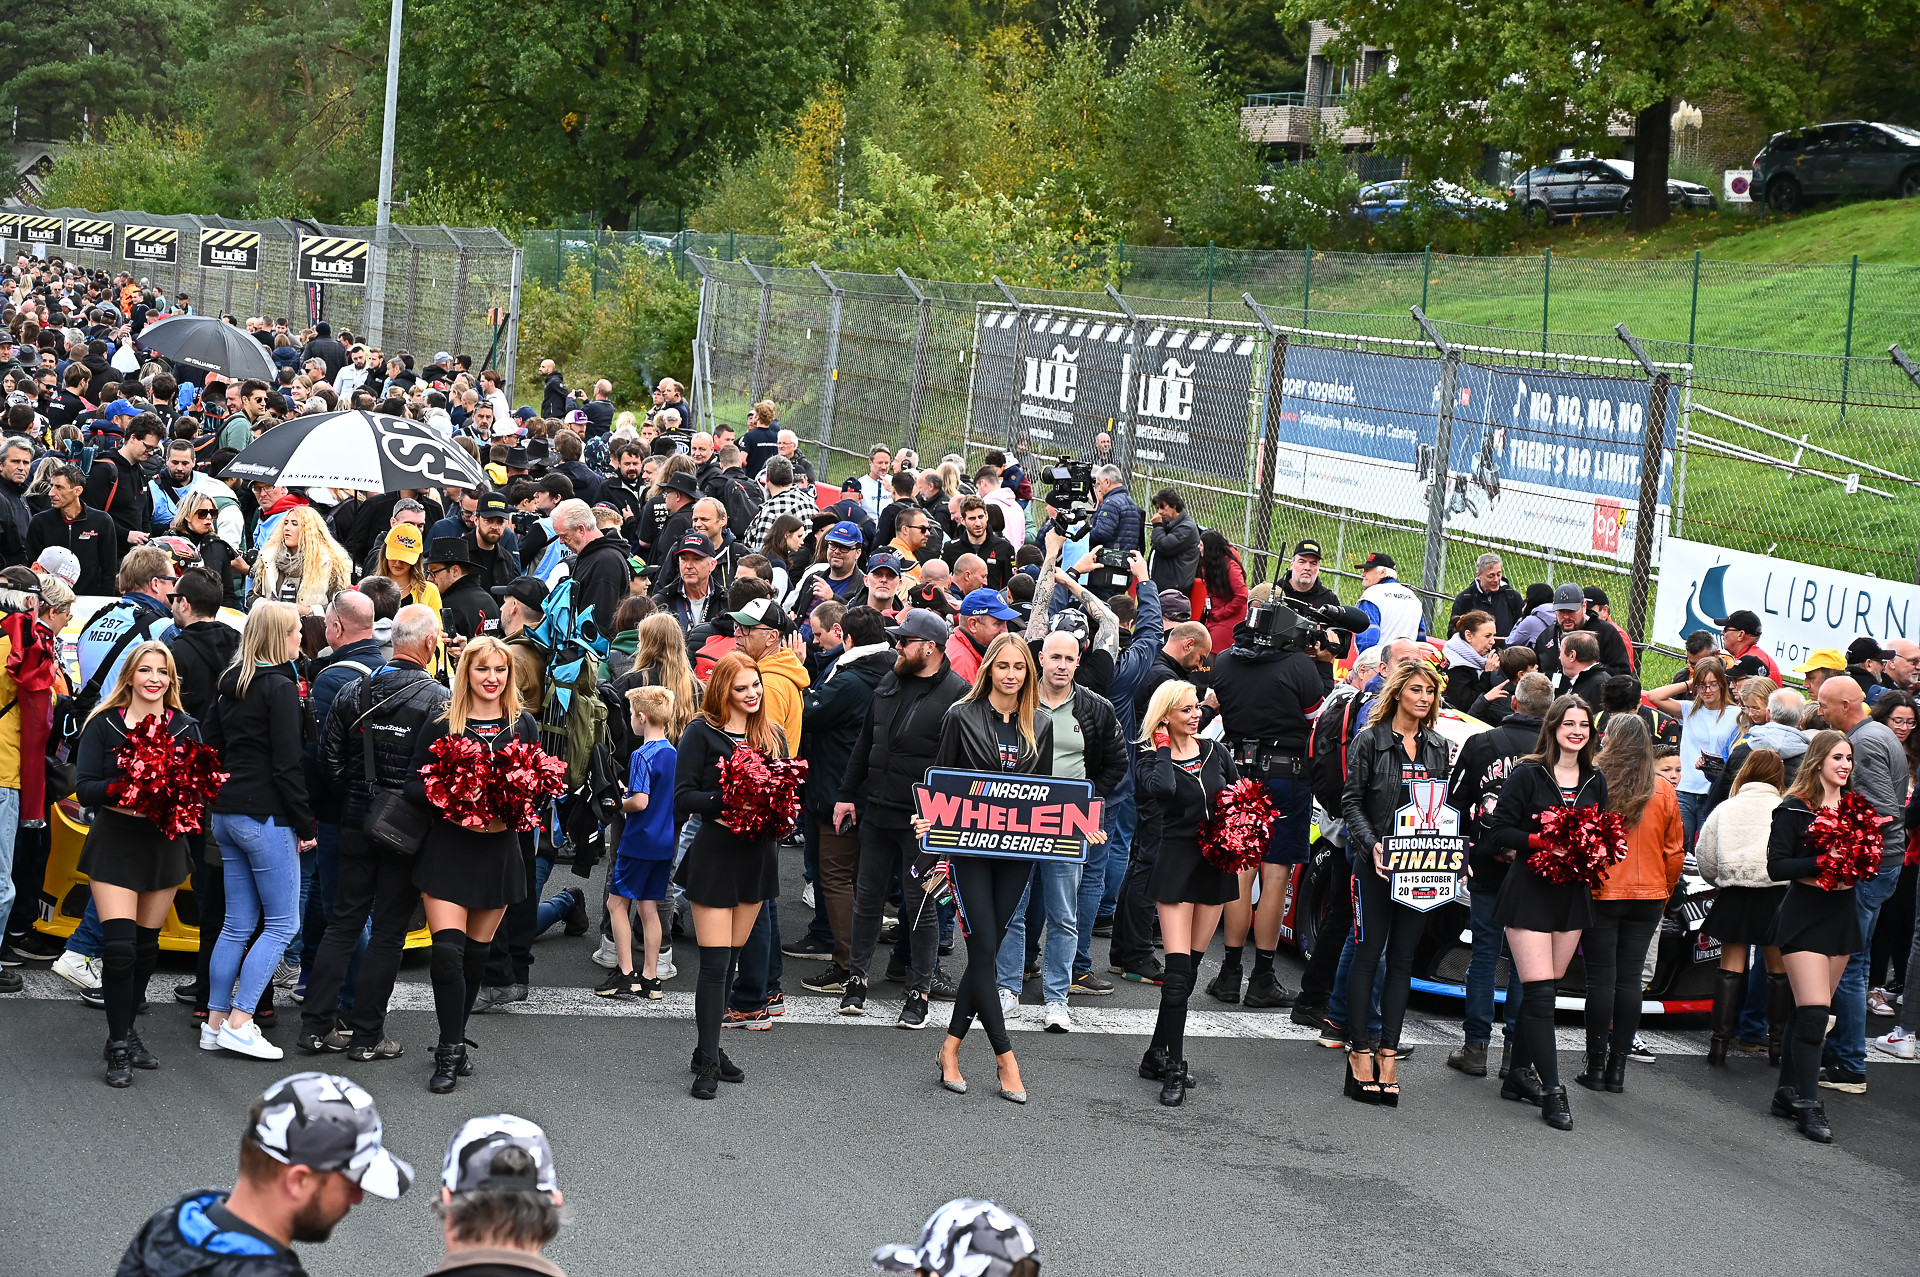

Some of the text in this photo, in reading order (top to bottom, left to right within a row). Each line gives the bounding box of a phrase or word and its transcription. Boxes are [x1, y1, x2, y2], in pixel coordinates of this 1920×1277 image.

[1307, 378, 1357, 401] opgelost.
[1530, 391, 1643, 434] NO, NO, NO, NO
[1510, 438, 1642, 486] THERE'S NO LIMIT.
[1429, 469, 1434, 484] 3
[1619, 509, 1626, 526] 2
[1764, 572, 1911, 640] LIBURN
[99, 617, 125, 630] 287
[88, 630, 118, 643] MEDI
[1775, 641, 1811, 665] HOT
[988, 781, 1050, 801] NASCAR
[916, 787, 1102, 836] WHELEN
[958, 831, 1055, 853] EURO SERIES
[1388, 838, 1464, 851] EURONASCAR
[1388, 850, 1464, 870] FINALS
[1399, 875, 1452, 884] 14-15 OCTOBER
[1398, 887, 1409, 896] 20
[1439, 887, 1450, 896] 23
